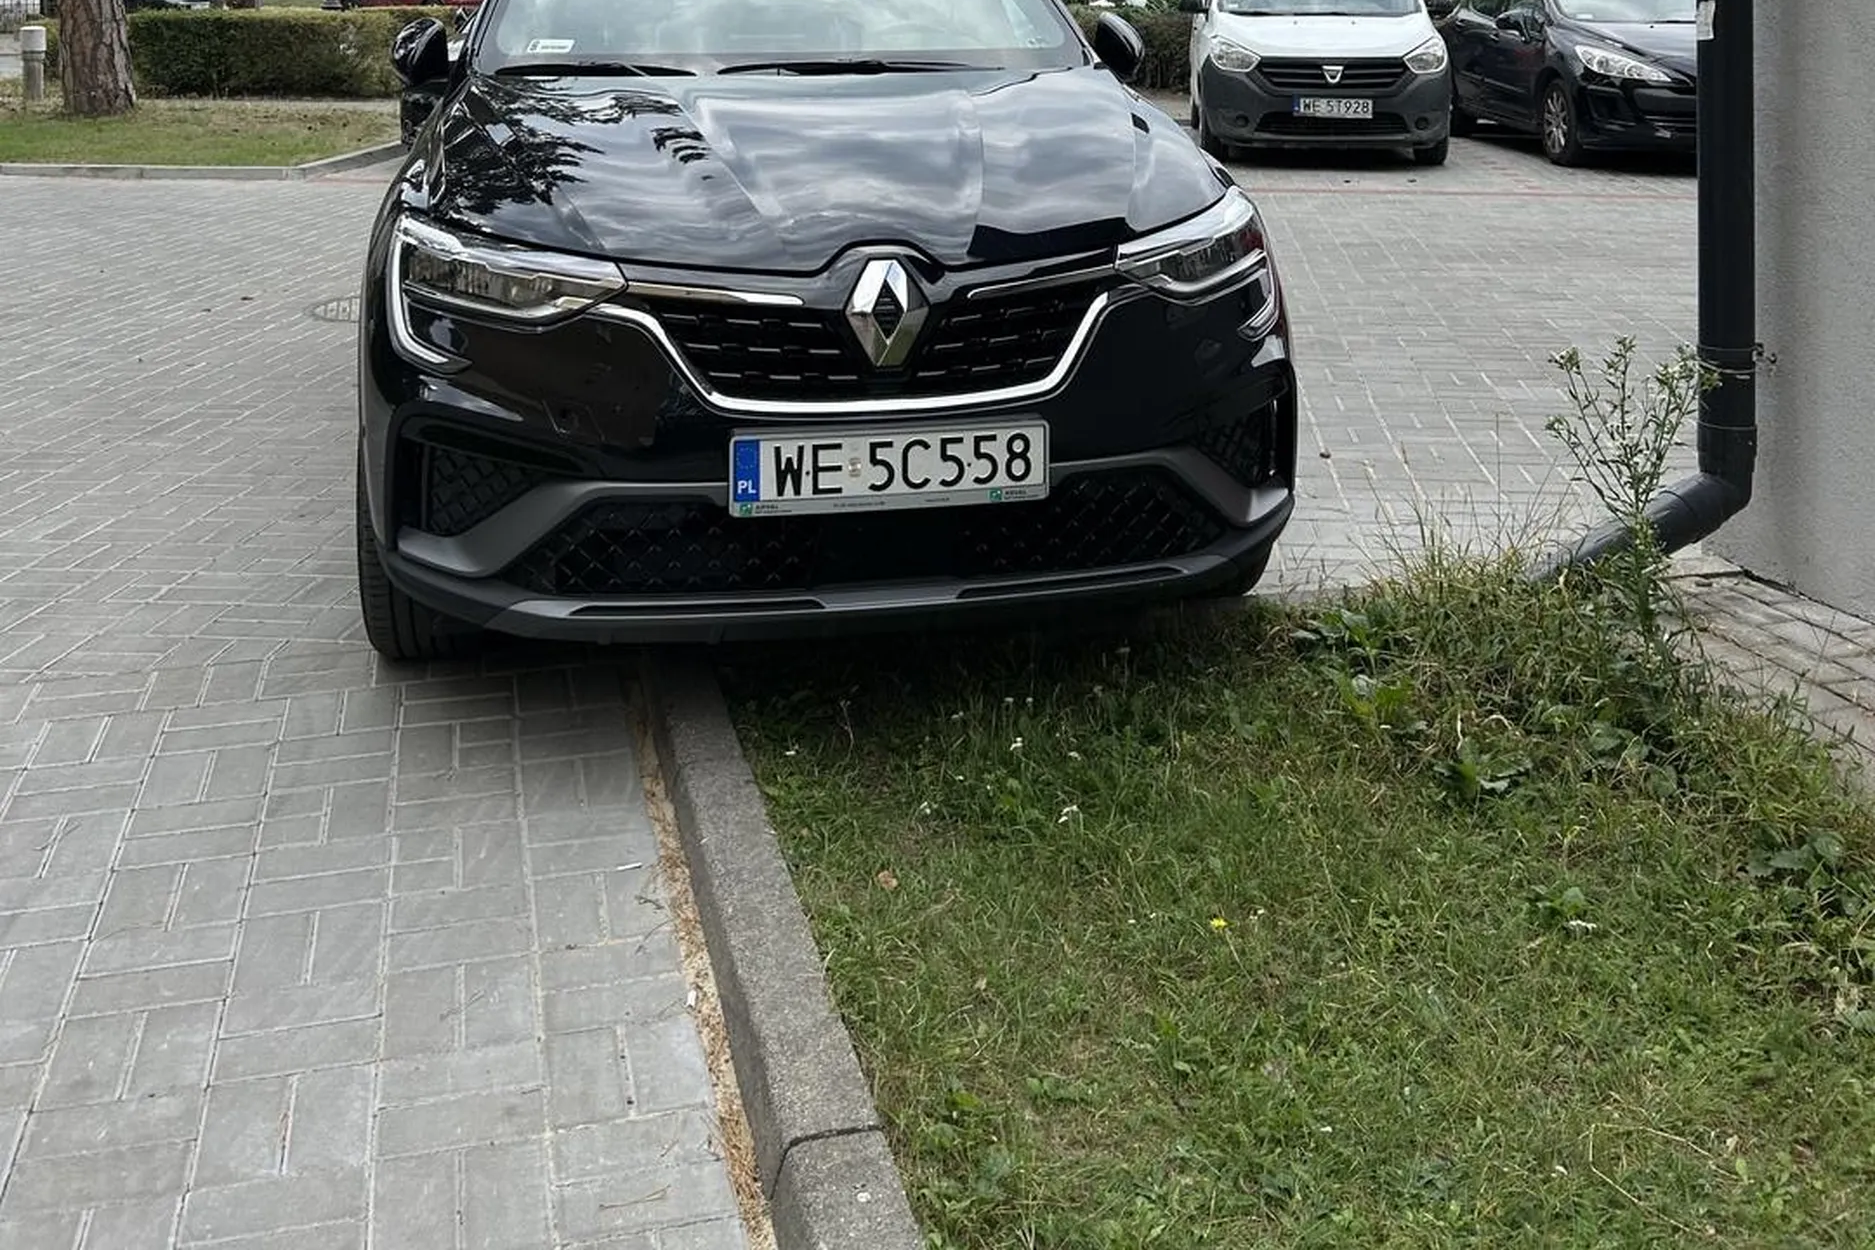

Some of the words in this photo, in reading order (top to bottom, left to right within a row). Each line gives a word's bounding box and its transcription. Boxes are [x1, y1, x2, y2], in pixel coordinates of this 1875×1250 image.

[1302, 99, 1321, 112] WE
[1326, 100, 1370, 114] 5T928
[773, 443, 843, 497] WE
[868, 432, 1032, 492] 5C558
[737, 480, 757, 494] PL
